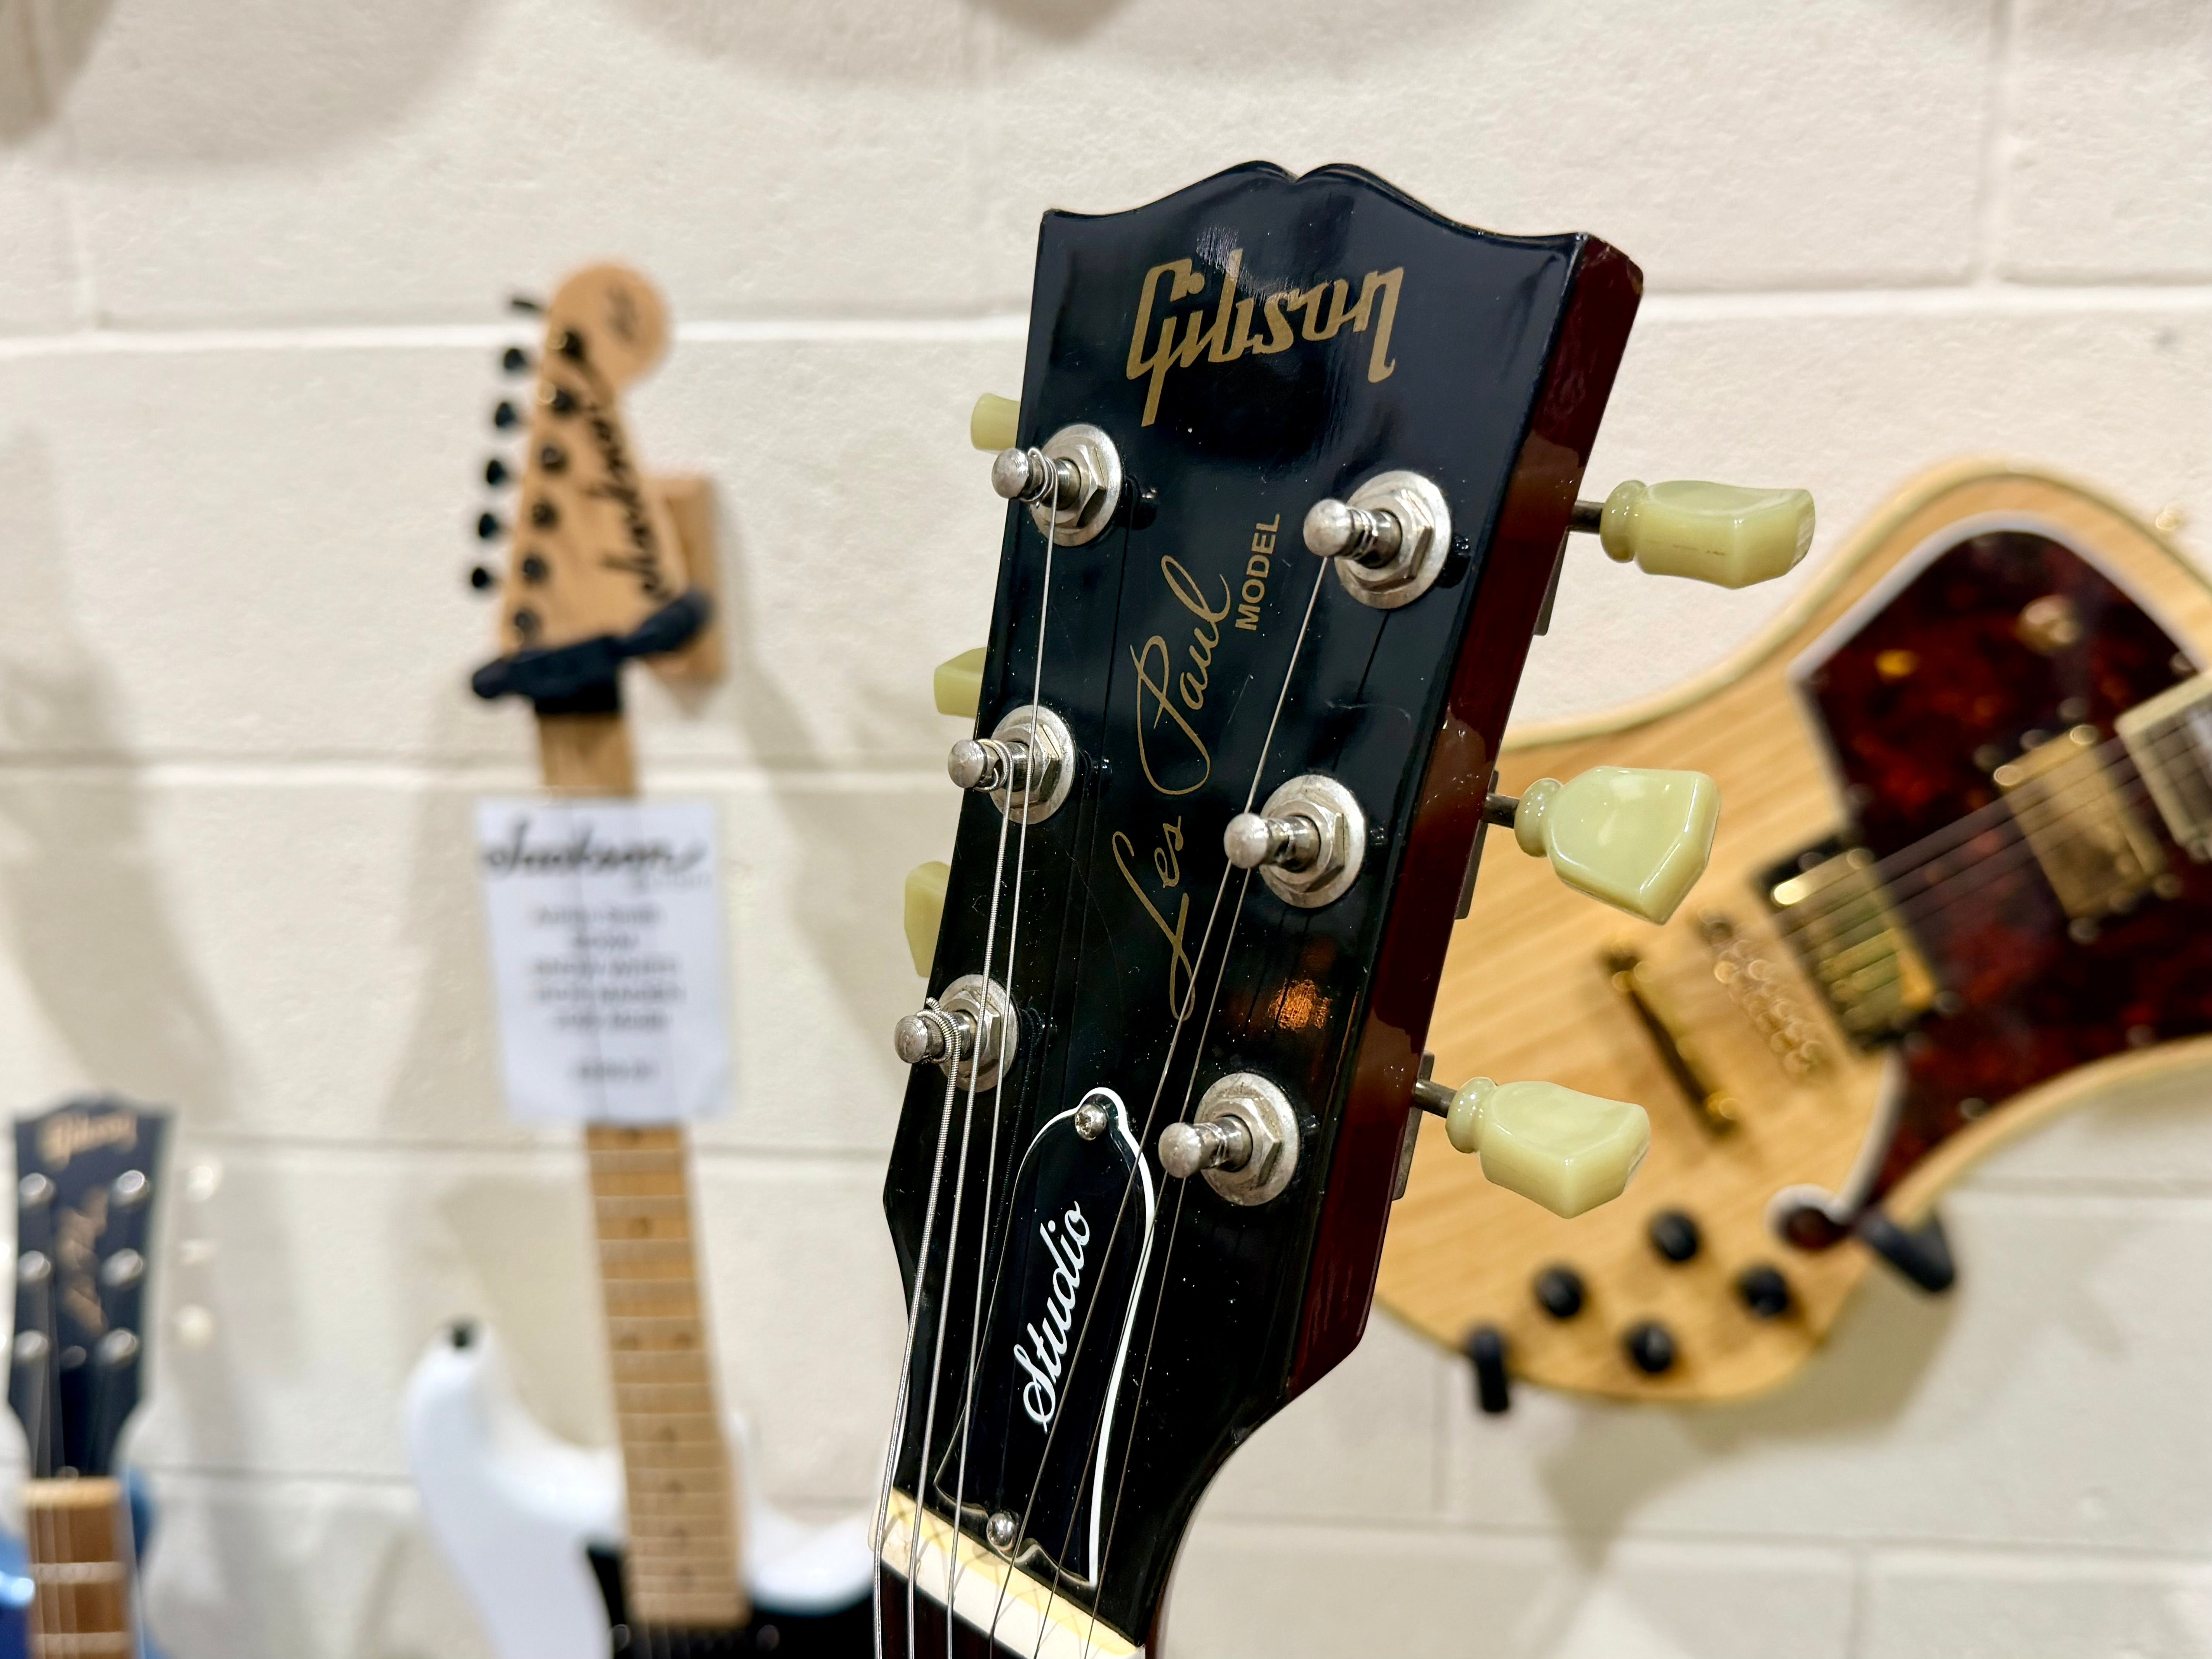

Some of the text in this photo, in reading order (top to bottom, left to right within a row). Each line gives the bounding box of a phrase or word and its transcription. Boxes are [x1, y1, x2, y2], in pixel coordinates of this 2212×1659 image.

[1126, 248, 1404, 427] Gibson
[1235, 514, 1281, 631] MODEL
[1112, 555, 1231, 1021] Les Paul
[1013, 1200, 1090, 1433] Studio
